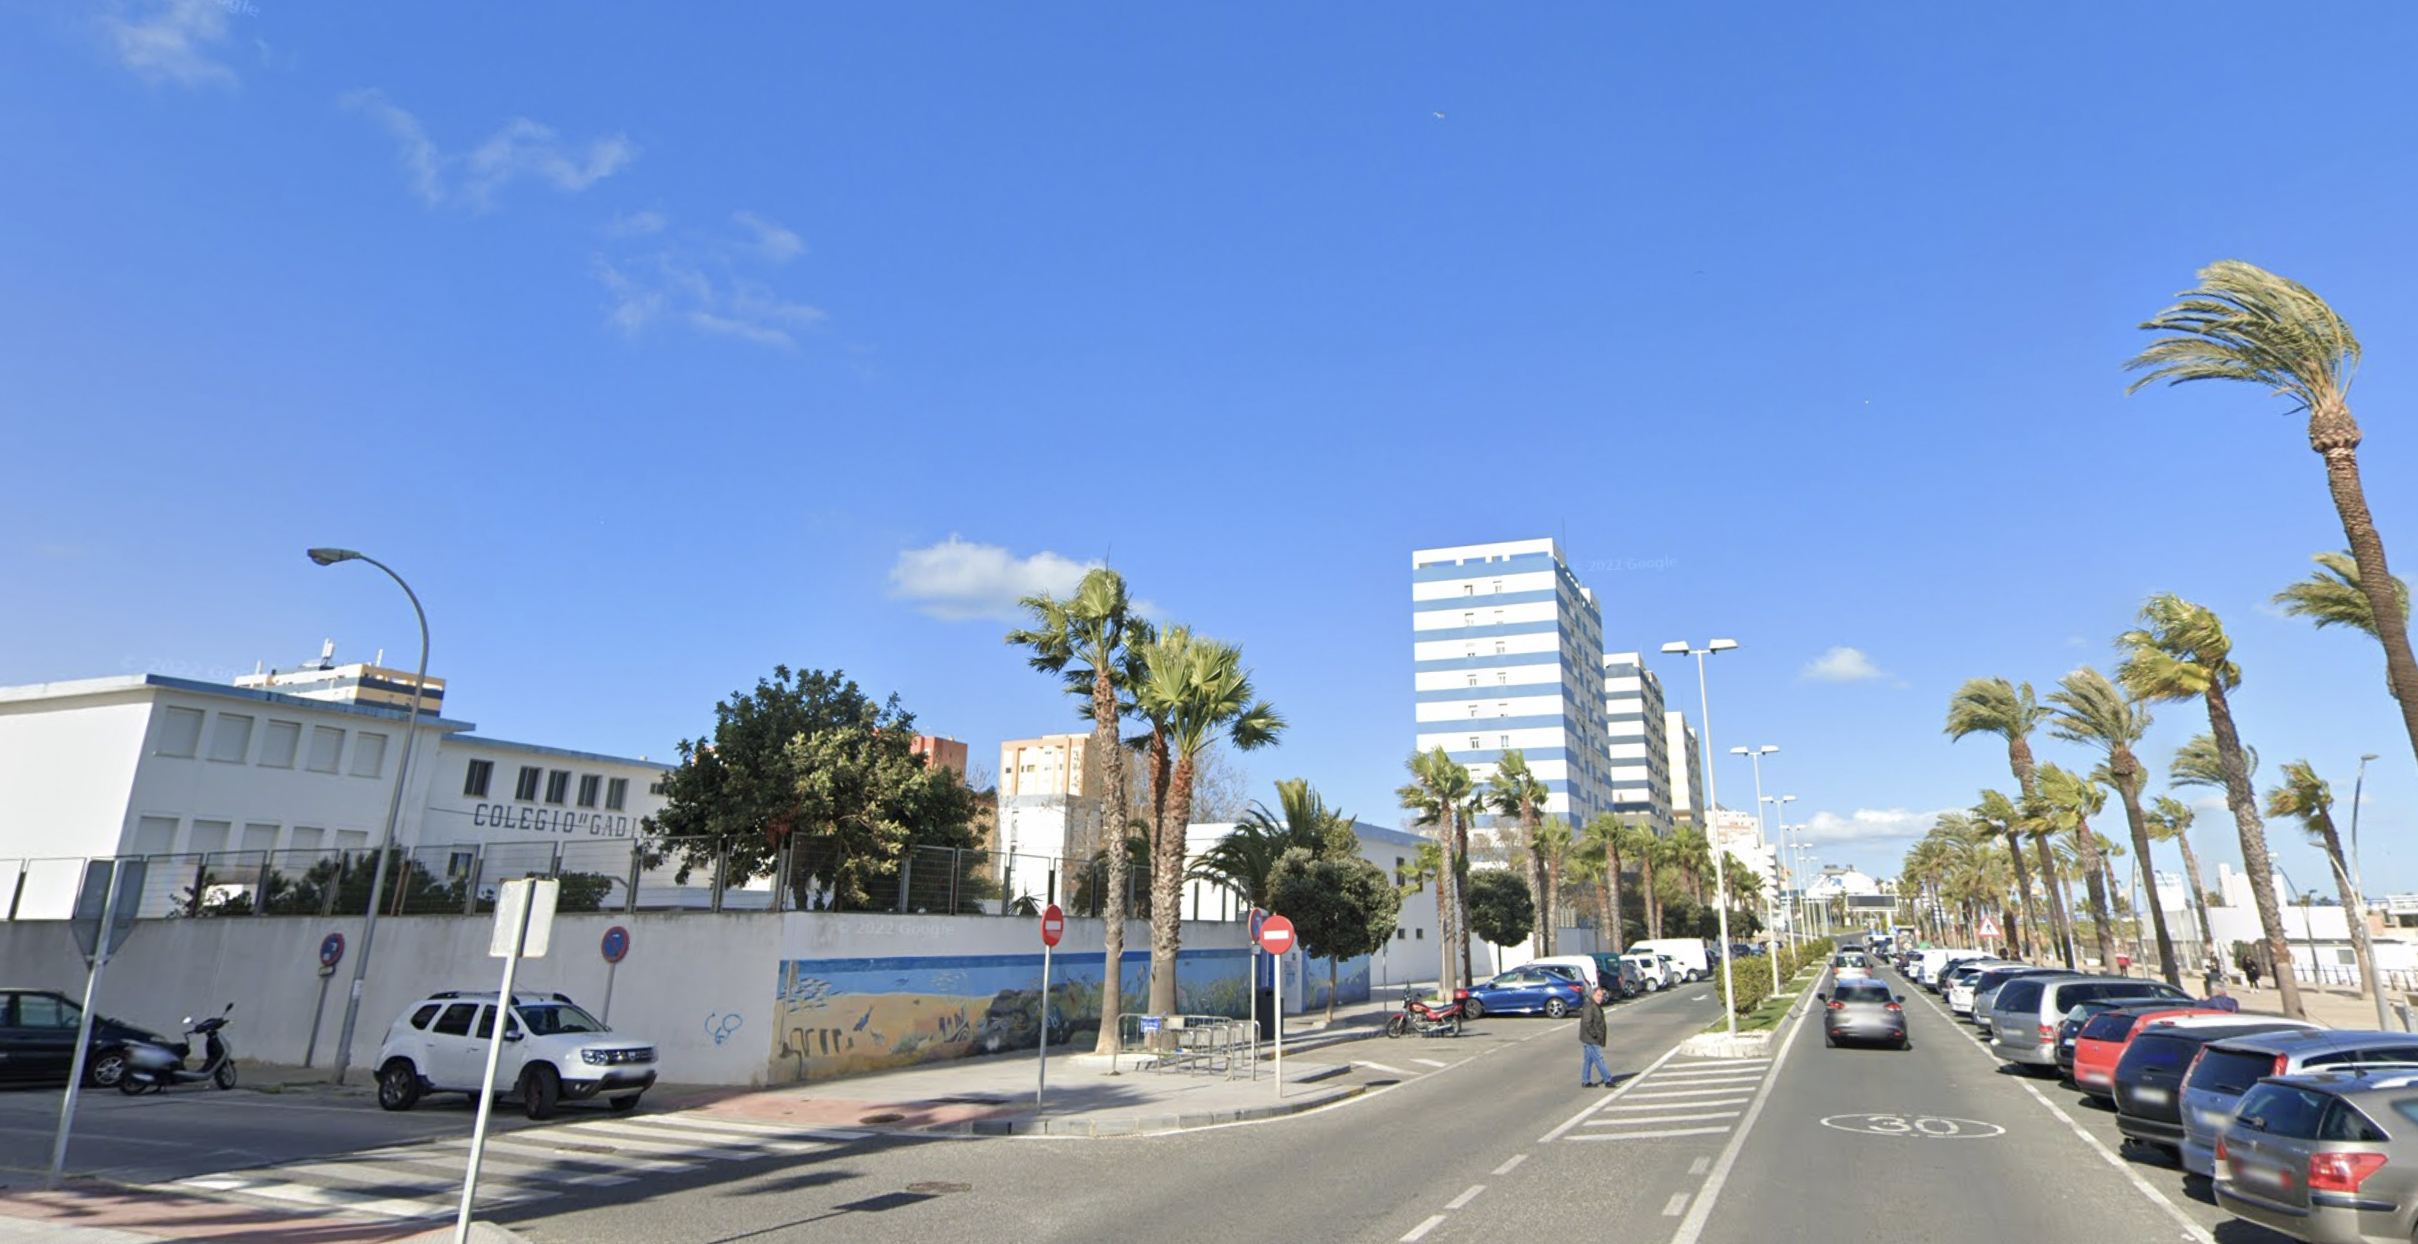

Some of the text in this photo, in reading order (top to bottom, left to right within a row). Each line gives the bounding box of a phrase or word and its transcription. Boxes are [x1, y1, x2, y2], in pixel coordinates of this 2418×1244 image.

[474, 803, 646, 839] COLEGIO "GADI
[1867, 1116, 1960, 1135] 30
